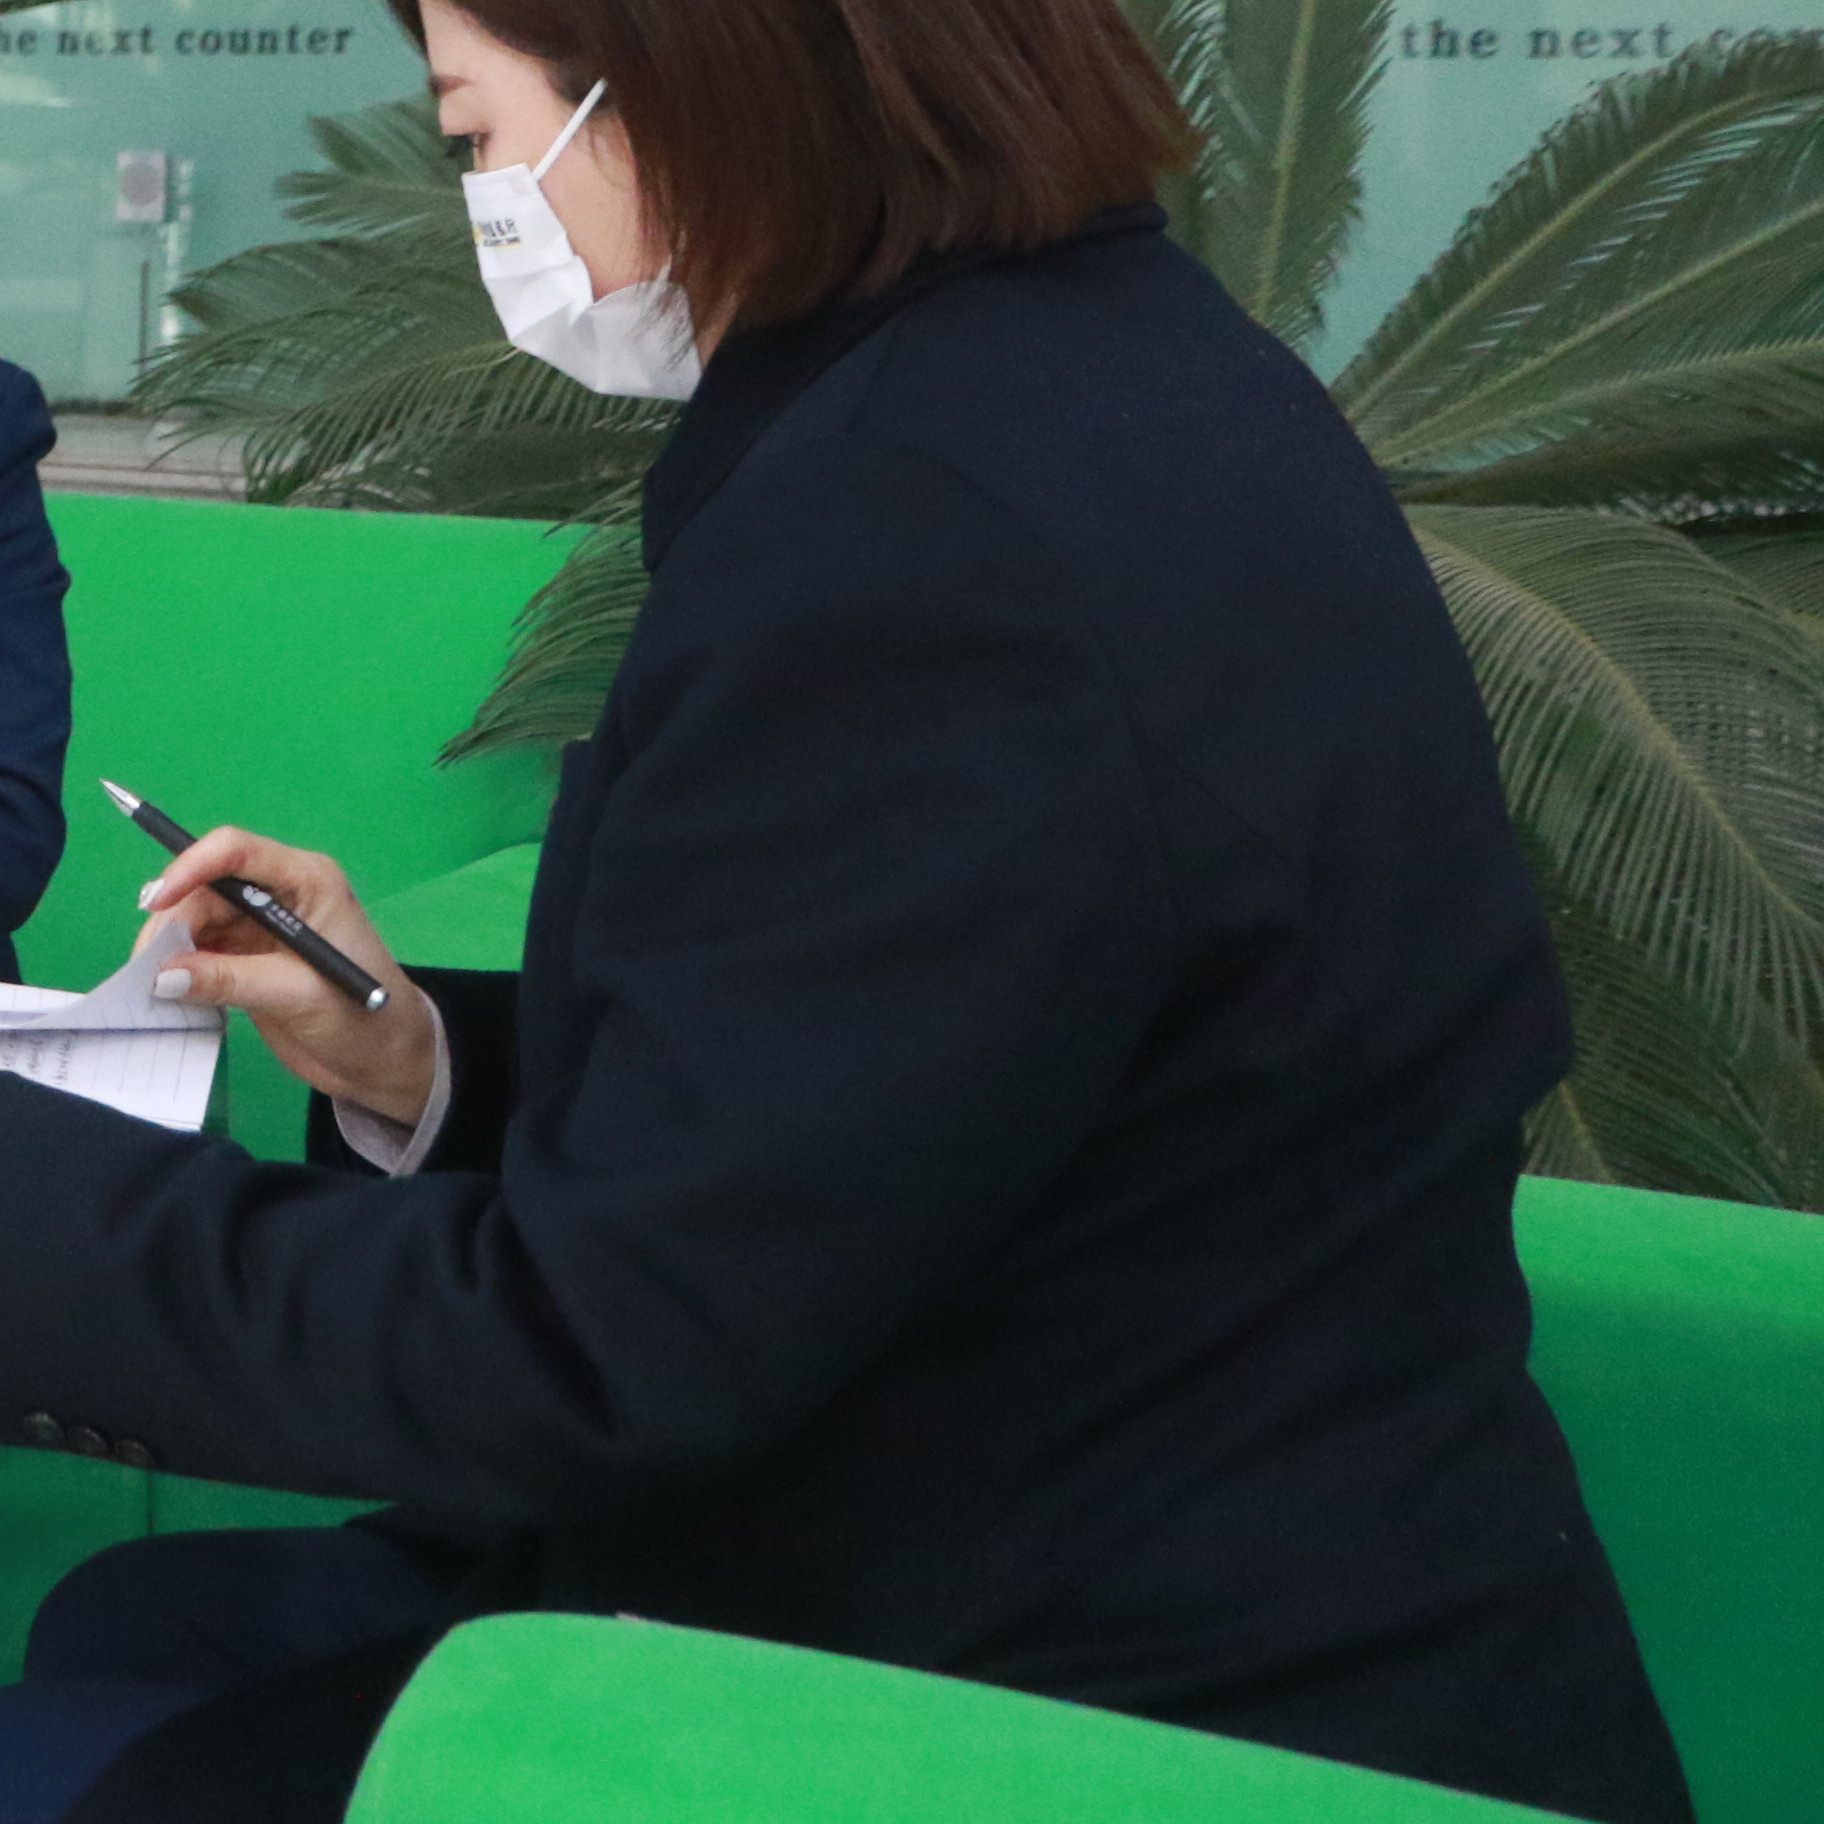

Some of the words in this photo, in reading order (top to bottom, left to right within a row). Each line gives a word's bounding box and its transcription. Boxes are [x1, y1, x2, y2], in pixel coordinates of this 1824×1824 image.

[58, 25, 154, 56] next
[174, 24, 356, 55] counter
[1400, 18, 1499, 59] the
[1527, 22, 1675, 60] next
